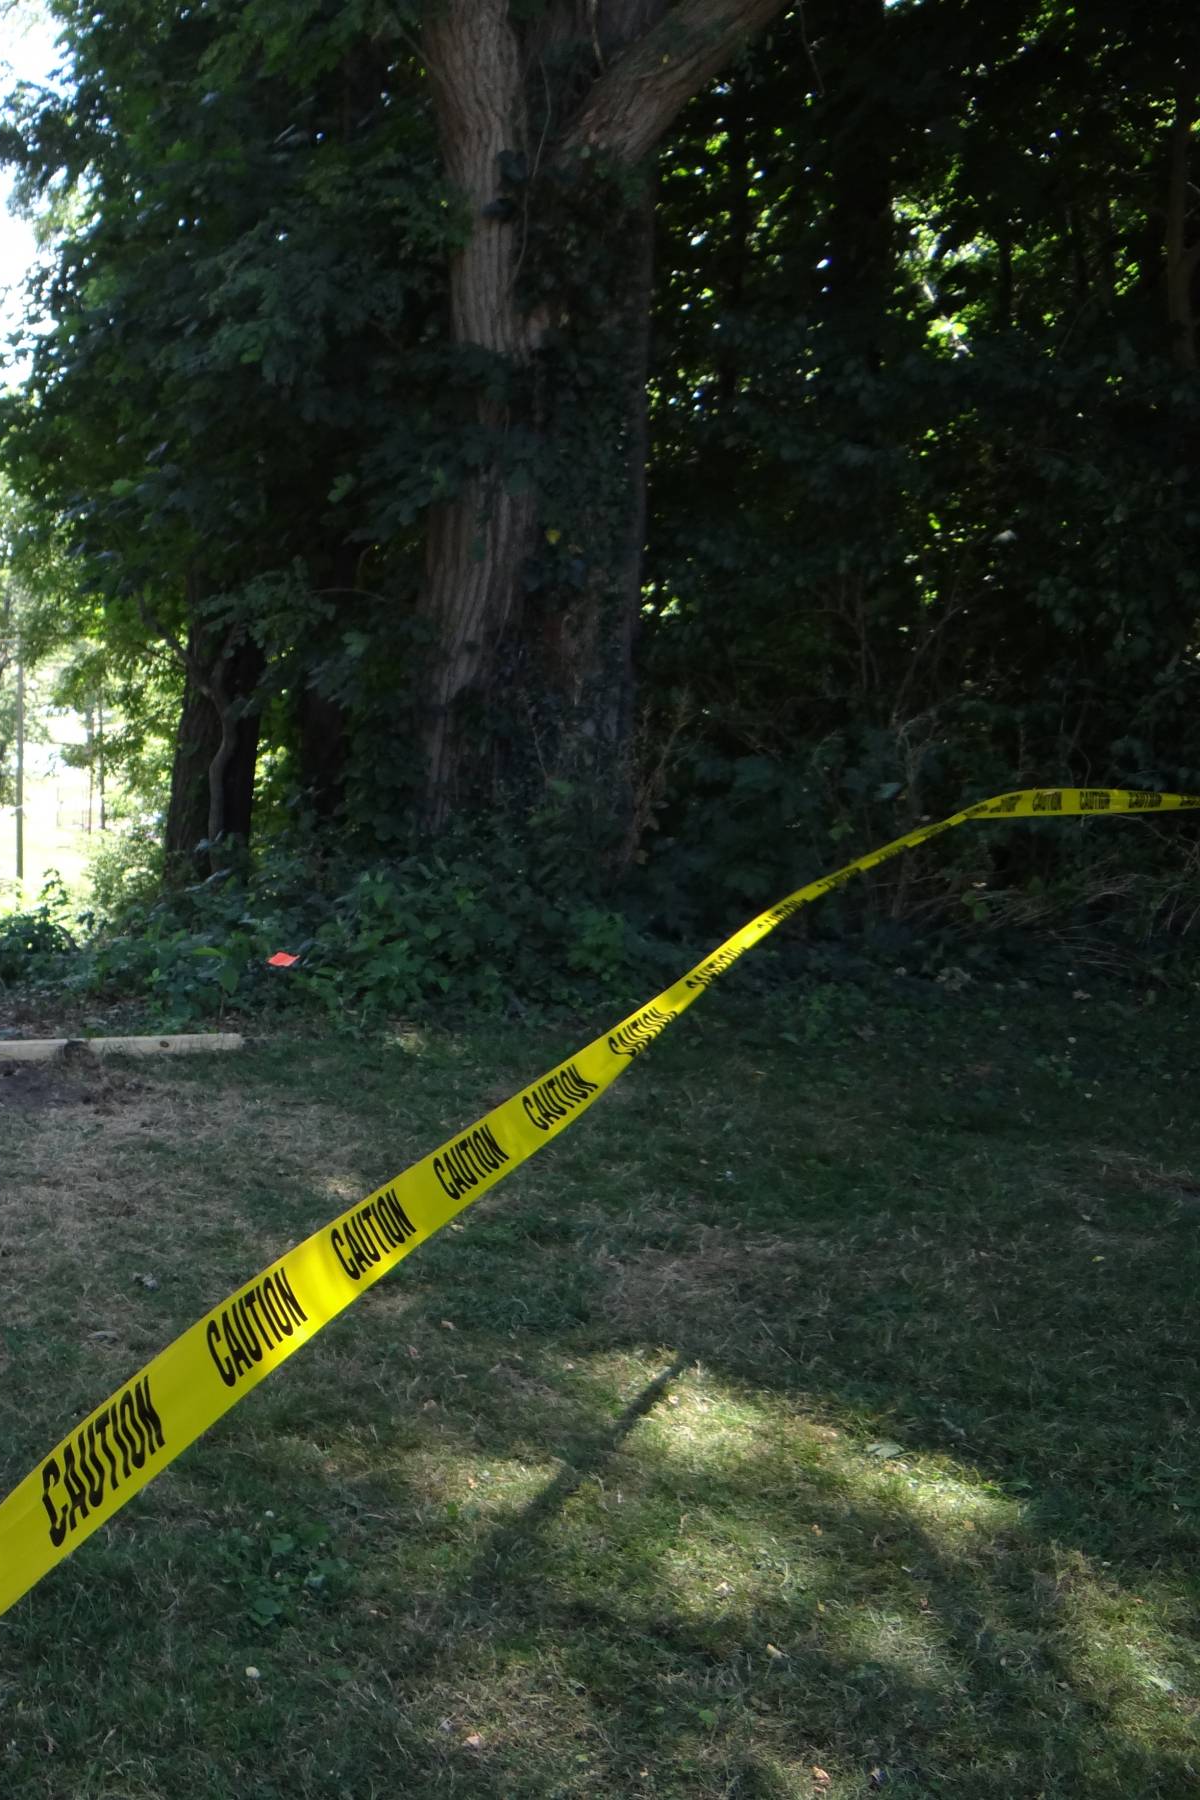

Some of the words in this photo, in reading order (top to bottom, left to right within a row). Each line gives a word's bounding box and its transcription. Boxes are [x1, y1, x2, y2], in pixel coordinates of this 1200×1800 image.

[522, 1063, 598, 1131] CAUTION
[433, 1124, 510, 1200] CAUTION
[331, 1188, 417, 1281] CAUTION
[206, 1267, 309, 1387] CAUTION
[42, 1376, 166, 1547] CAUTION
